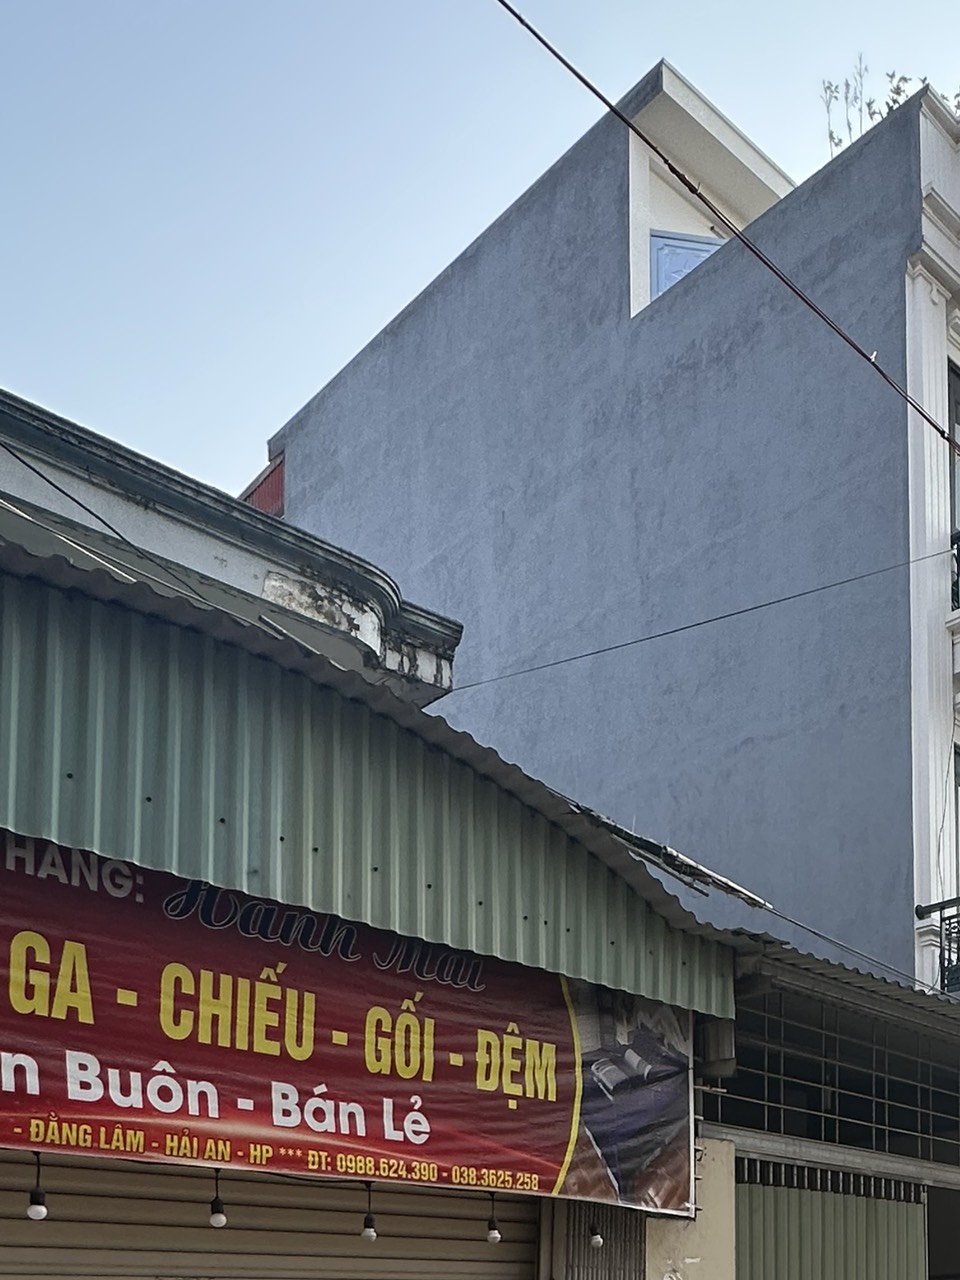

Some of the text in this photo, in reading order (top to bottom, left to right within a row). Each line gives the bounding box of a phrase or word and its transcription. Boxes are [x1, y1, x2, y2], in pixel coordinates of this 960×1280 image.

[8, 930, 95, 1025] GA
[159, 962, 316, 1062] CHIẾU
[364, 991, 436, 1082] GỐI
[475, 1022, 557, 1110] ĐỆM
[65, 1049, 220, 1119] Buôn
[271, 1081, 366, 1137] Bán
[382, 1095, 431, 1145] Lẻ
[29, 1112, 92, 1148] ĐẰNG
[100, 1124, 145, 1153] LÂM
[165, 1128, 198, 1158] HẢI
[203, 1139, 231, 1162] AN
[249, 1143, 274, 1165] HP
[307, 1150, 331, 1171] ĐT:
[336, 1153, 438, 1182] 0988.624.390
[452, 1166, 539, 1191] 038.3625.258
